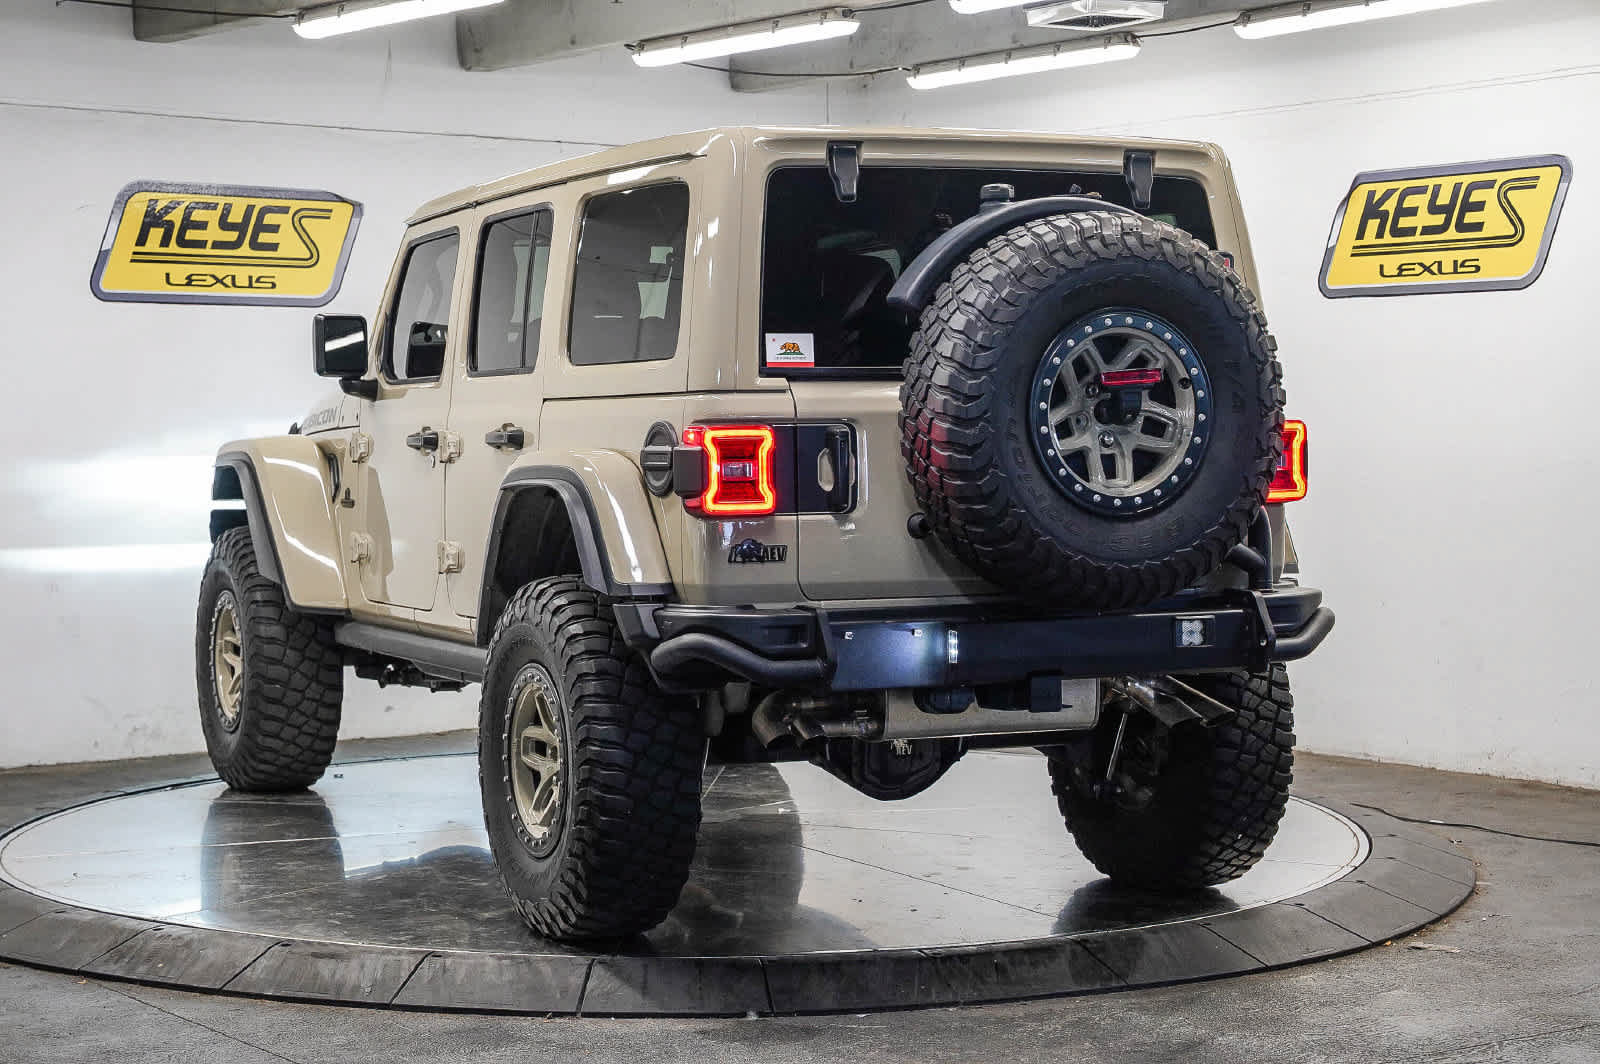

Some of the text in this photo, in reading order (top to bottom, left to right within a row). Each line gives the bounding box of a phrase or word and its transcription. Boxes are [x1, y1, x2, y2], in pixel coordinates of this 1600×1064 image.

[131, 199, 333, 268] KEYES
[1351, 176, 1541, 257] KEYES
[165, 272, 277, 289] LEXUS
[1379, 258, 1481, 278] LEXUS
